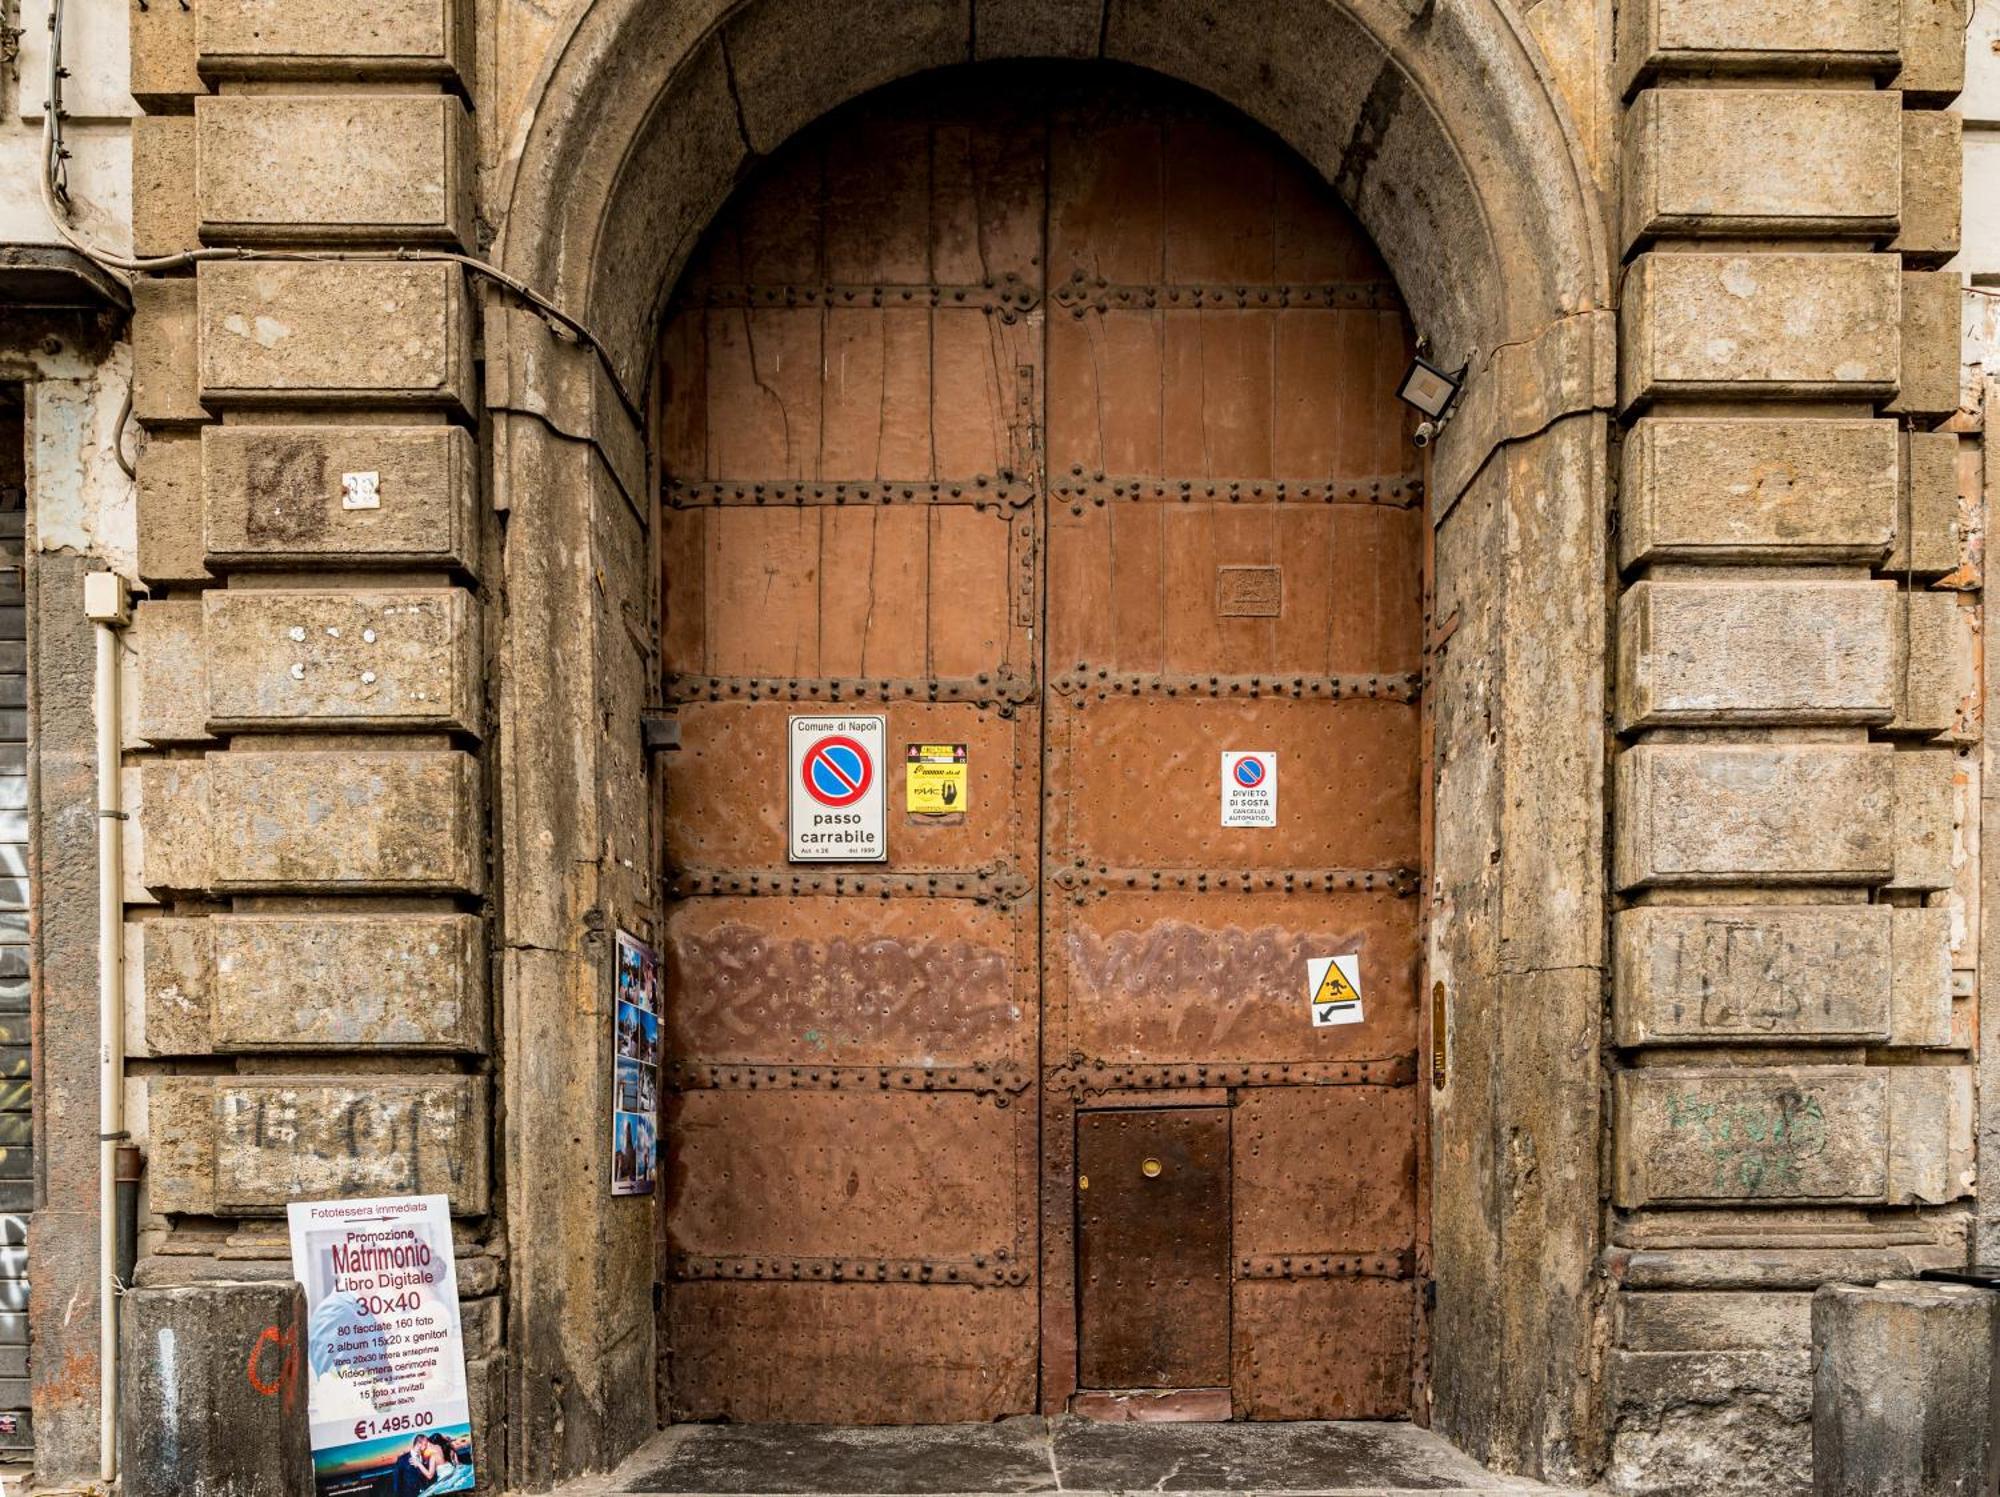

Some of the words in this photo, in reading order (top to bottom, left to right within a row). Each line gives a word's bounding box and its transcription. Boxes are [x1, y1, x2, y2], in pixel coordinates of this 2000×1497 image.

[798, 721, 834, 731] Comune
[838, 721, 846, 731] di
[849, 721, 877, 733] Napoli
[813, 814, 861, 826] passo
[800, 830, 875, 843] carrabile
[311, 1206, 373, 1219] Fototessera
[375, 1202, 428, 1216] immediata
[347, 1228, 415, 1244] Promozione
[331, 1238, 431, 1275] Matrimonio
[335, 1277, 374, 1293] Libro
[379, 1271, 434, 1289] Digitale
[356, 1291, 421, 1317] 30x40
[337, 1326, 350, 1337] 80
[353, 1322, 392, 1335] facciate
[396, 1318, 413, 1329] 160
[415, 1316, 434, 1326] foto
[327, 1343, 334, 1354] 2
[337, 1339, 369, 1352] album
[372, 1334, 402, 1348] 15x20
[413, 1329, 448, 1344] genitori
[338, 1368, 365, 1379] Video
[395, 1358, 437, 1372] cerimonia
[360, 1390, 370, 1399] 15
[354, 1411, 433, 1440] €1.495.00
